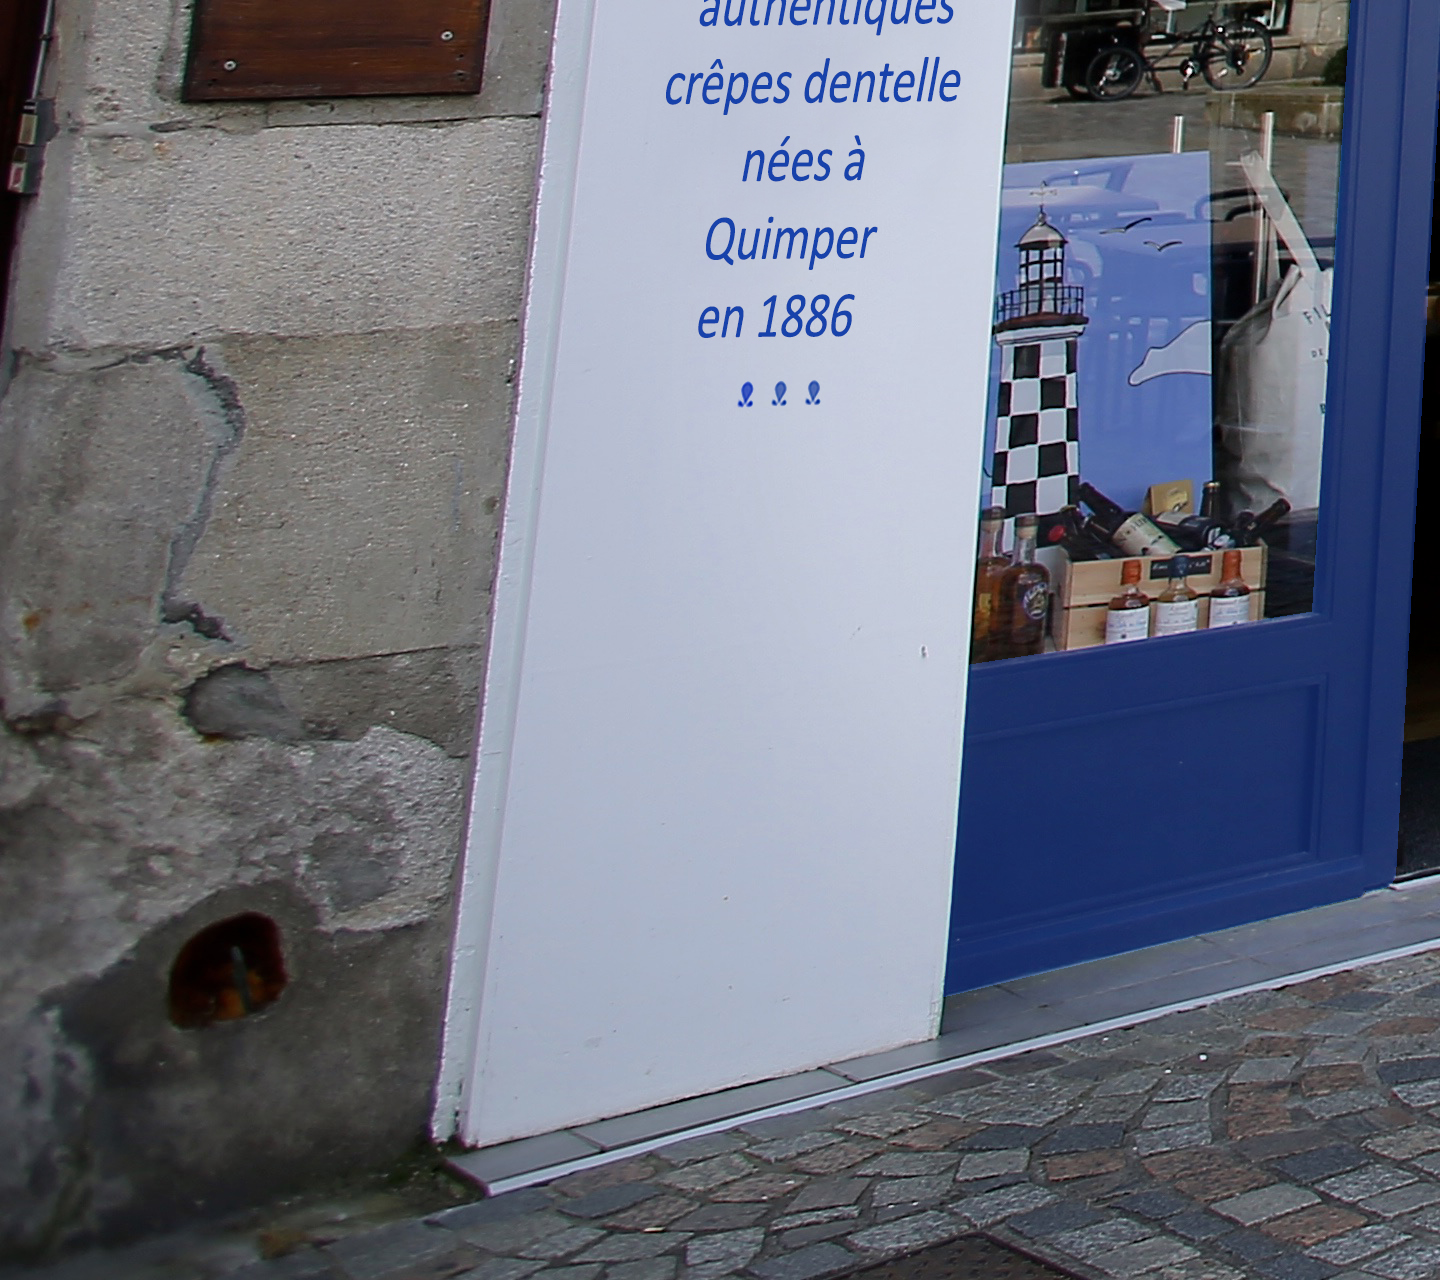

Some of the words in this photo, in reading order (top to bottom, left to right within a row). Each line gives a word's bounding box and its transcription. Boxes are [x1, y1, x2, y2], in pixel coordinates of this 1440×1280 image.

[666, 59, 792, 115] crêpes
[805, 57, 960, 103] dentelle
[742, 136, 832, 182] nées
[844, 135, 865, 181] à
[706, 217, 877, 270] Quimper
[698, 306, 743, 338] en
[758, 294, 855, 338] 1886
